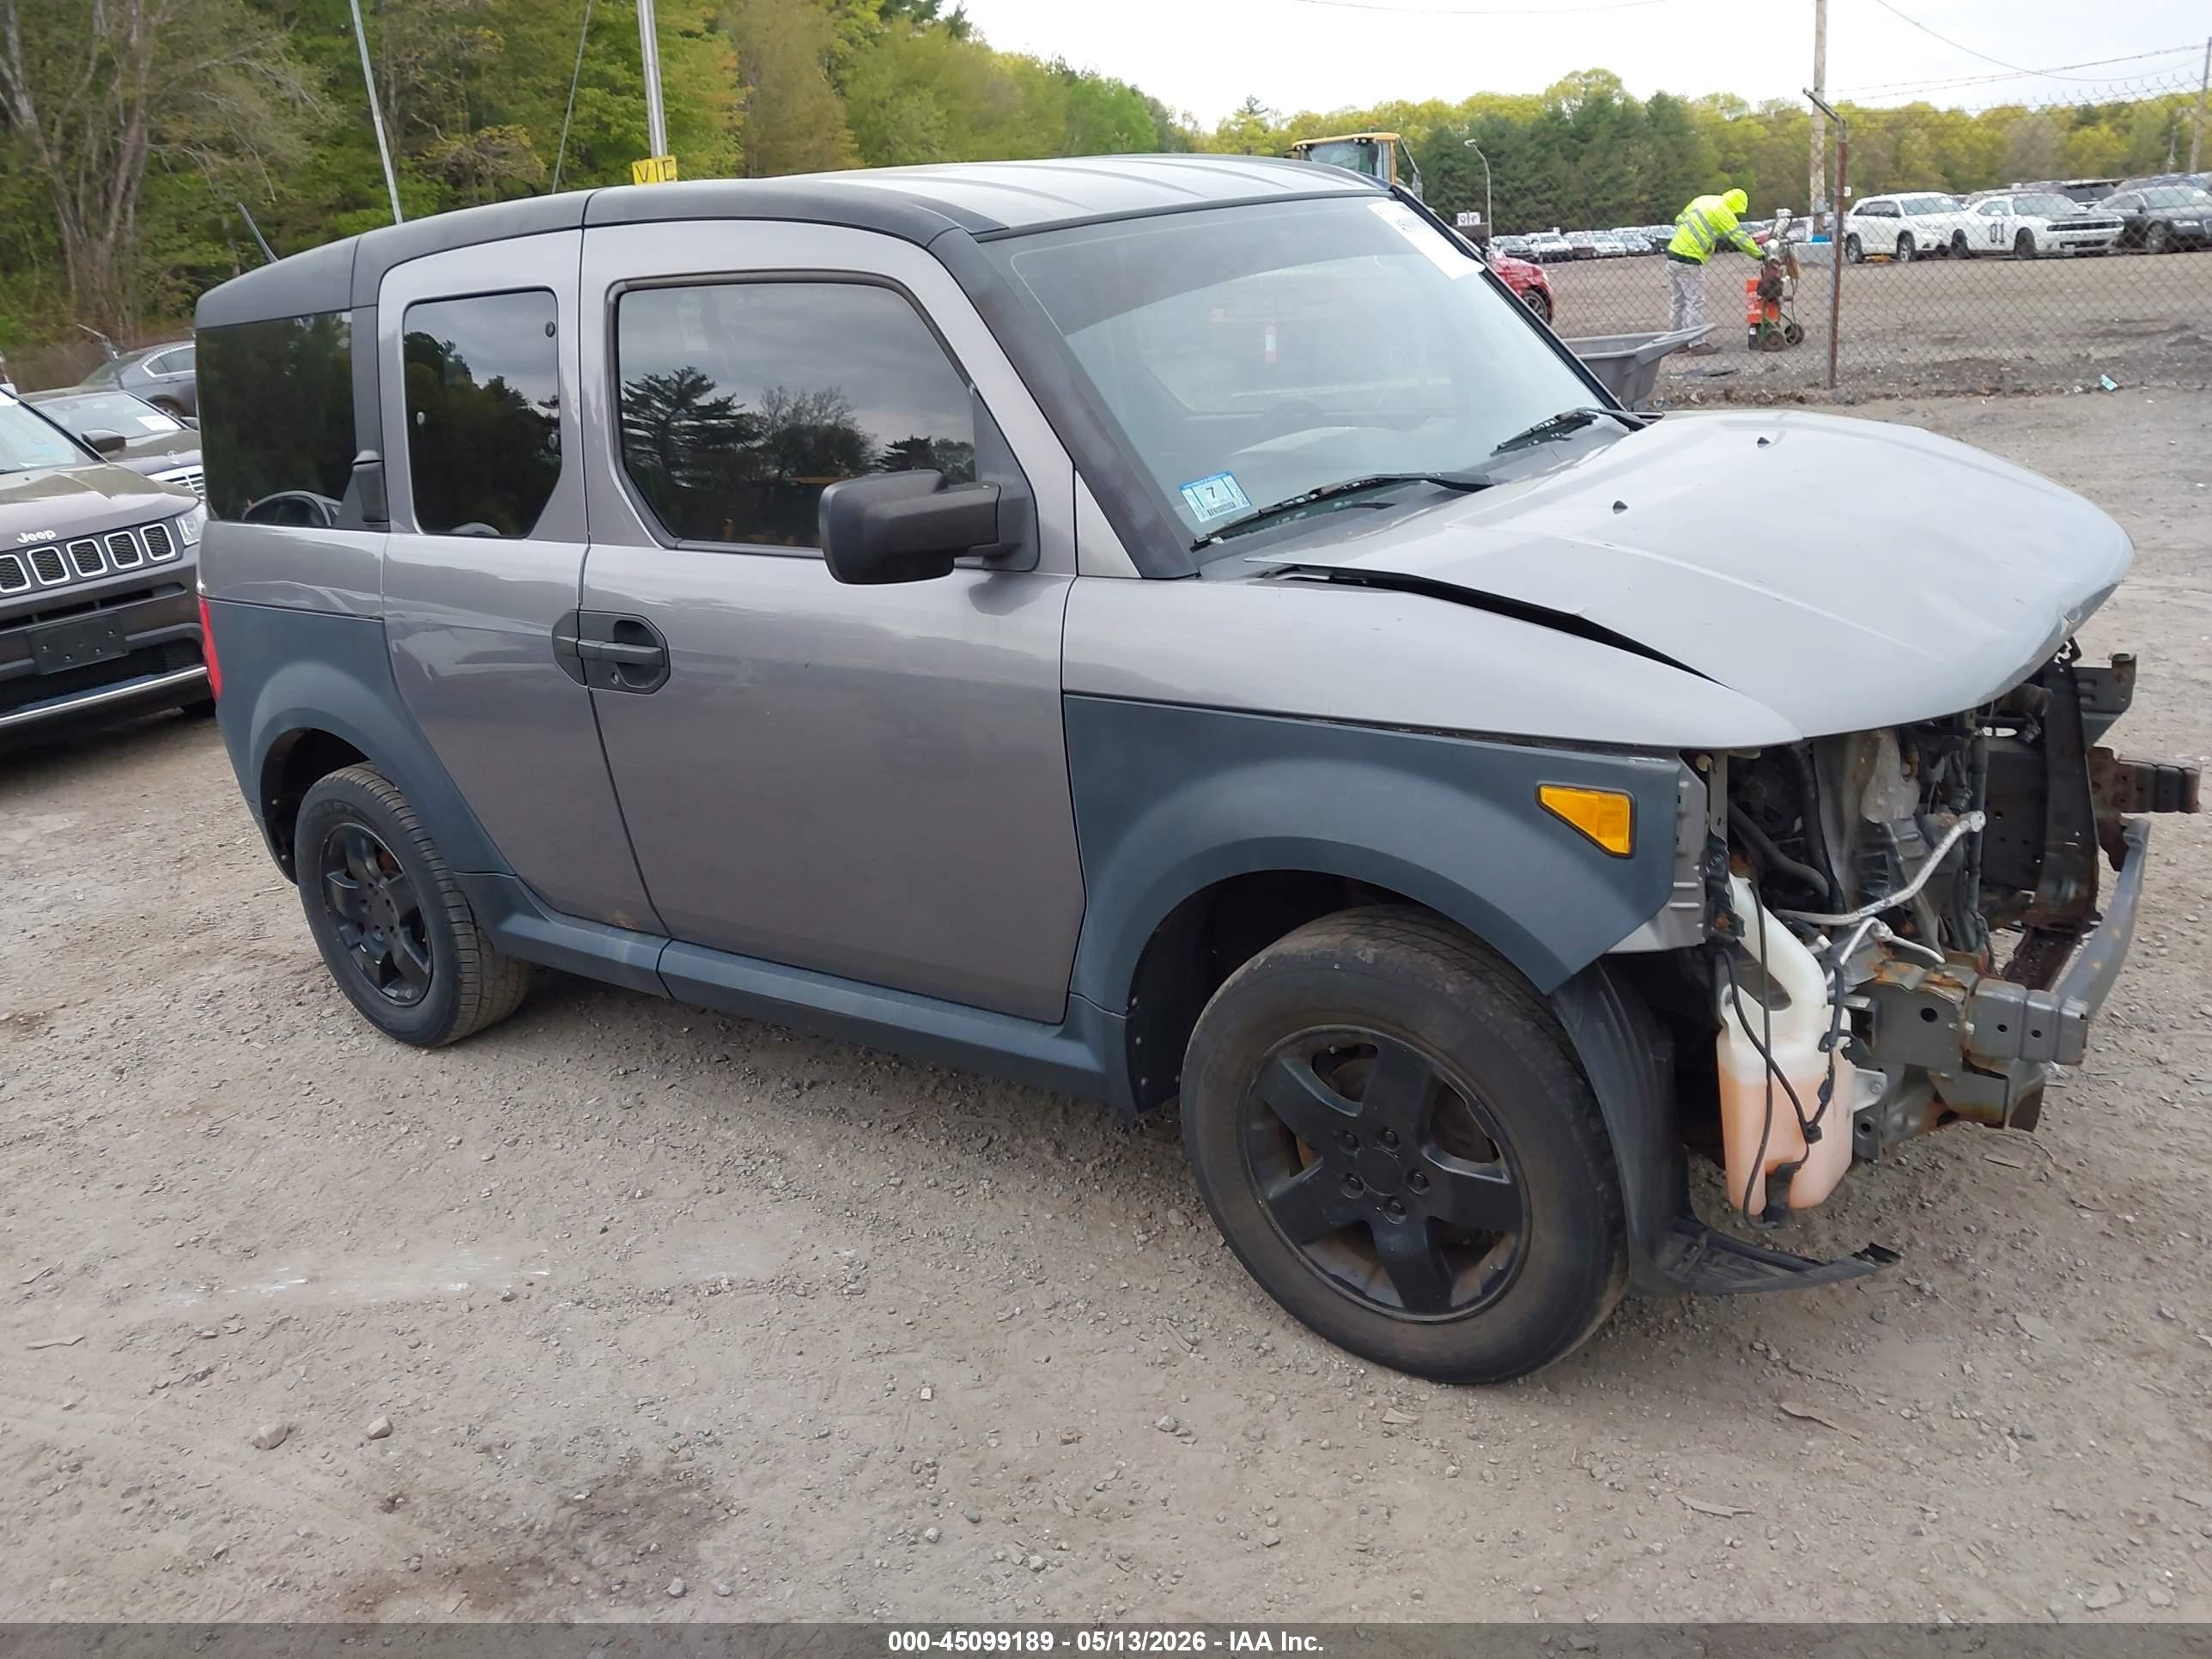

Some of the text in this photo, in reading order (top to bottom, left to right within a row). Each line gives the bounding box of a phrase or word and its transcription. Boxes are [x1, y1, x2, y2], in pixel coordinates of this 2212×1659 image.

[1990, 223, 2006, 246] 01
[1205, 487, 1216, 499] 7
[15, 528, 57, 544] Jeep
